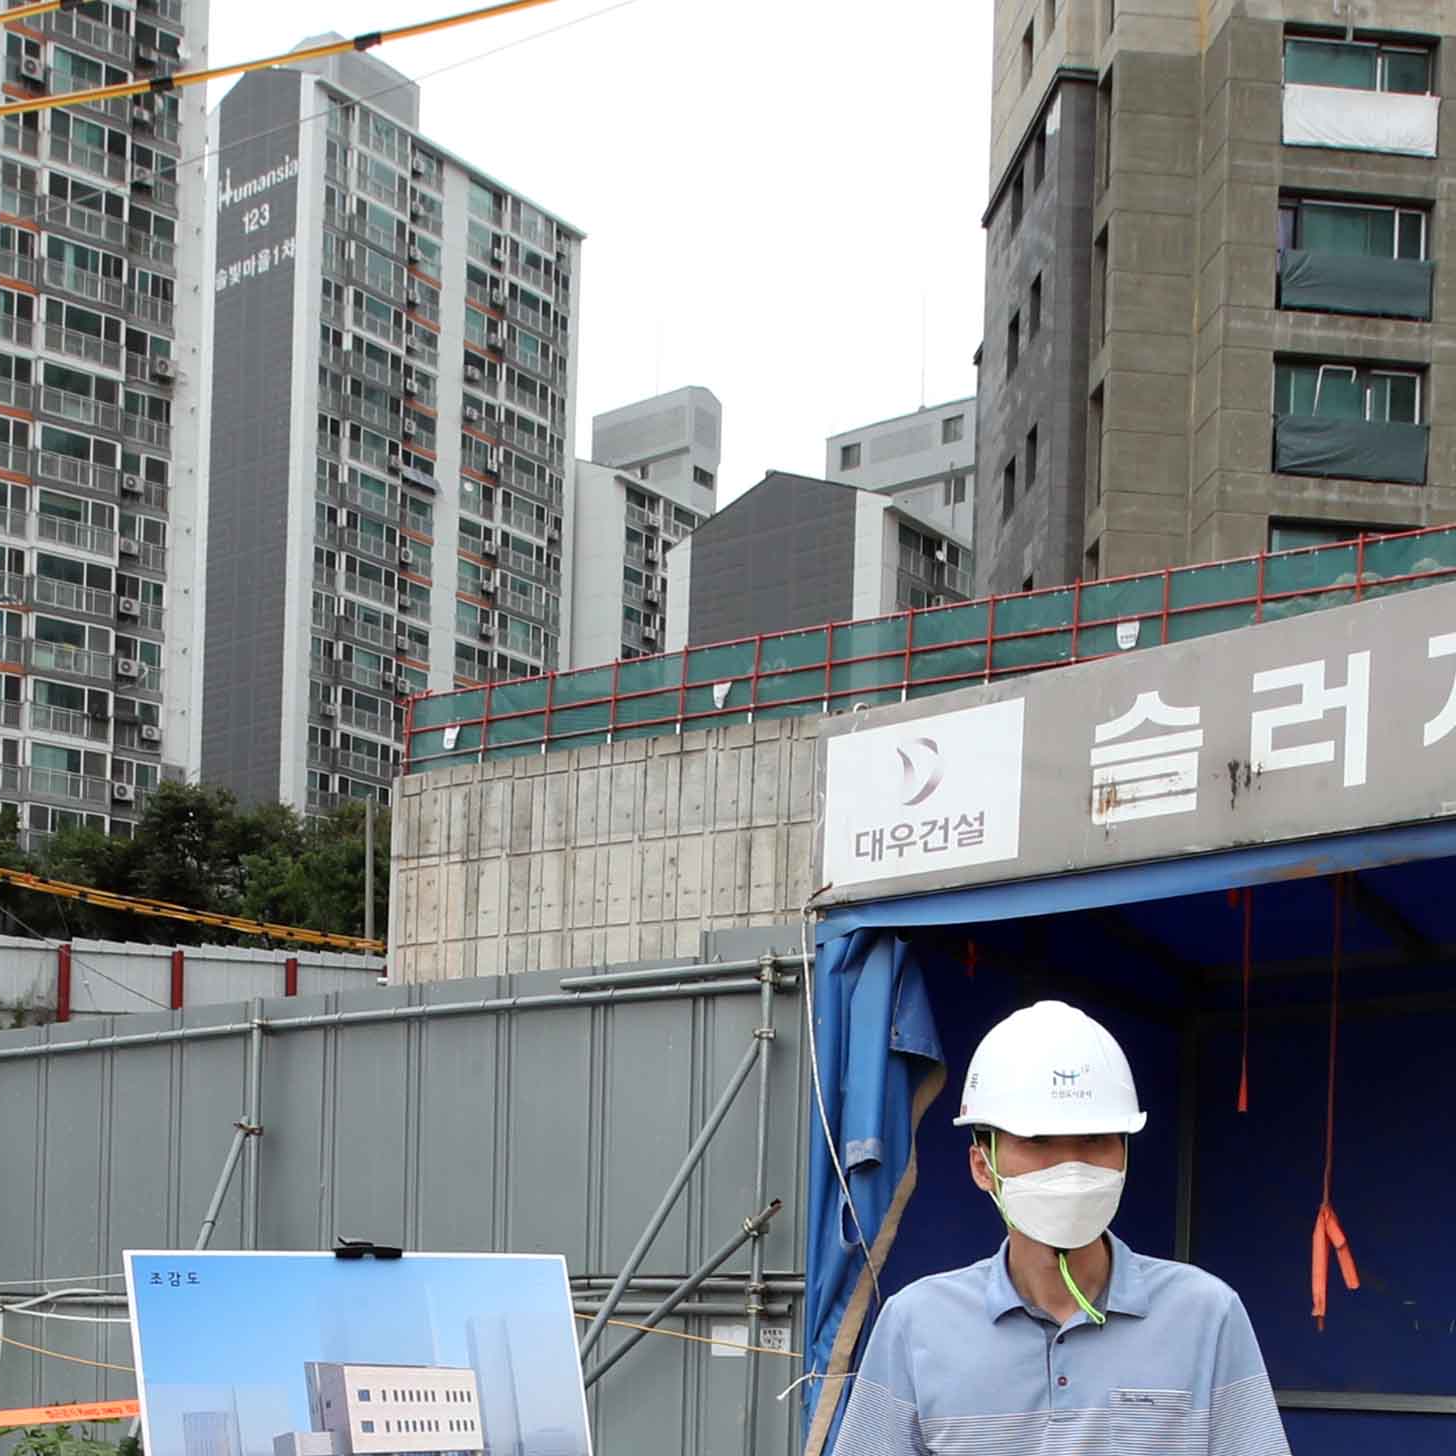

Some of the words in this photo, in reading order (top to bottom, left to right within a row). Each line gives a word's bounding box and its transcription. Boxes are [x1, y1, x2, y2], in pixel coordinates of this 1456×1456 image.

[218, 155, 303, 213] Humansia
[242, 204, 270, 235] 123
[854, 809, 987, 863] 대우건설
